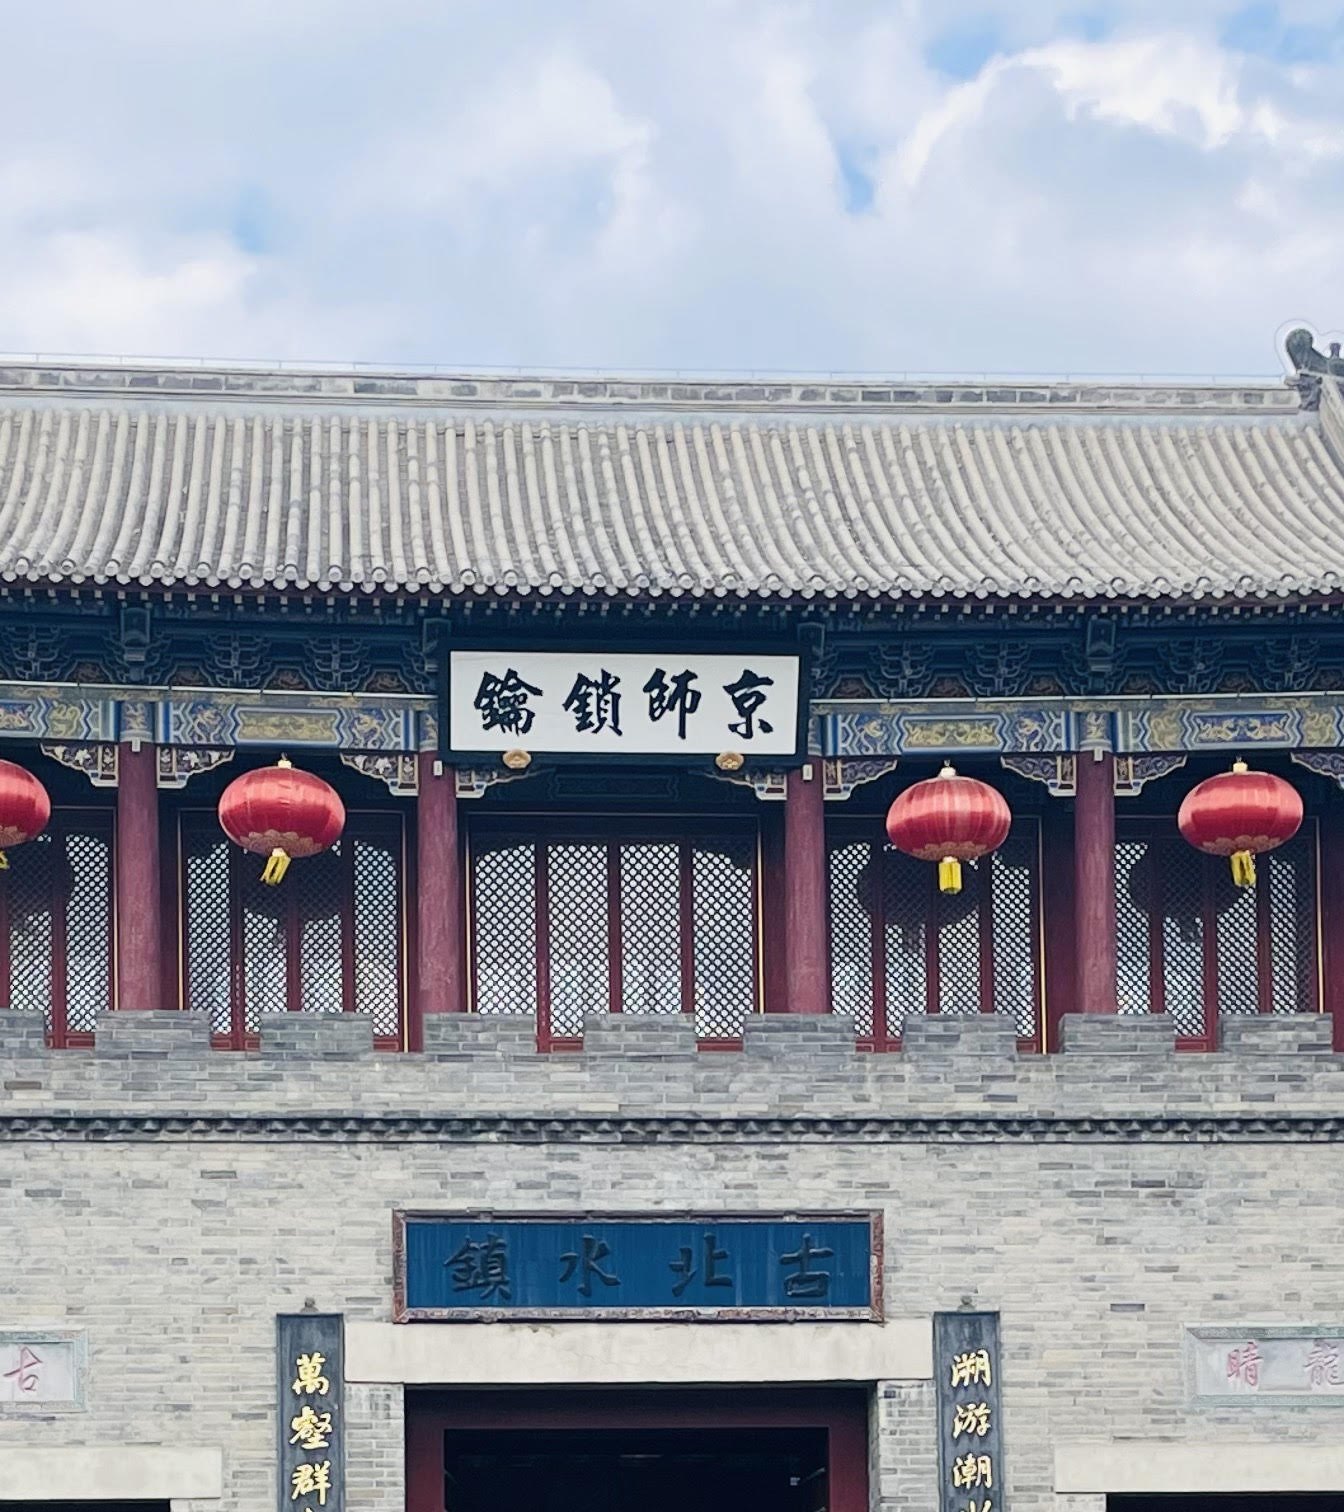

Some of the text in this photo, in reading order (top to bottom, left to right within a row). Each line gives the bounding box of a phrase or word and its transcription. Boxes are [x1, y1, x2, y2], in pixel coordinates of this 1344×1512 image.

[473, 668, 774, 740] 京師鎖鑰
[443, 1231, 834, 1300] 古北水鎮
